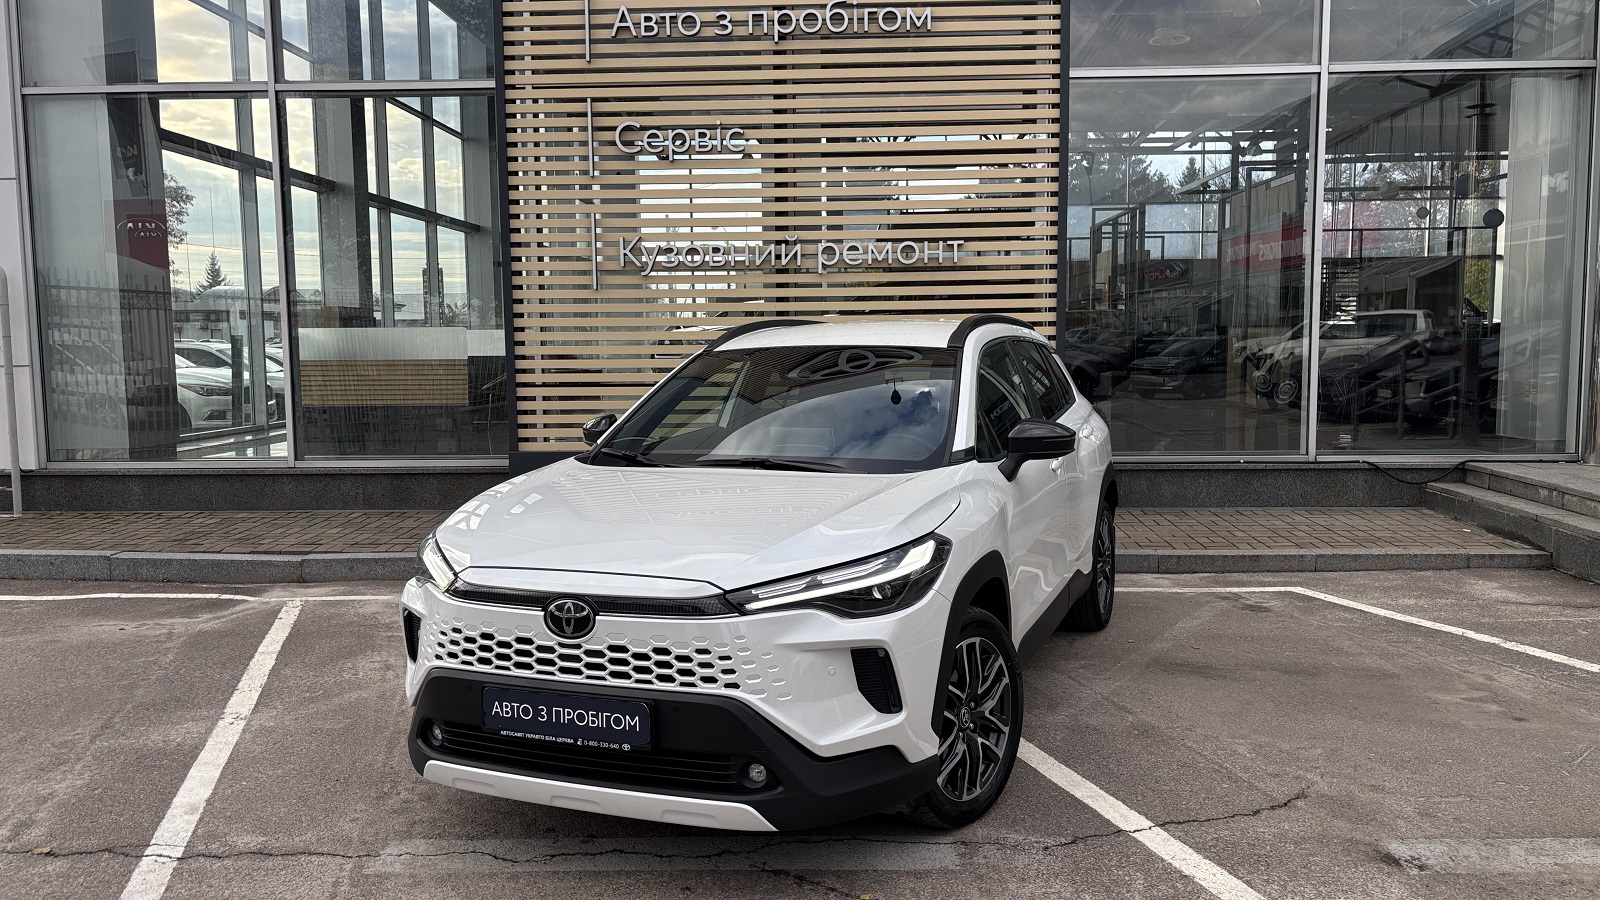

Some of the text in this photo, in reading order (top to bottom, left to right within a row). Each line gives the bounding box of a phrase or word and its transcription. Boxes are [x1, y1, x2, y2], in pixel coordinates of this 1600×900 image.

[611, 0, 932, 44] Авто з пробігом
[615, 119, 746, 162] Сервіс
[618, 234, 965, 276] Кузовний ремонт
[491, 701, 640, 731] АВТО З ПРОБІГОМ
